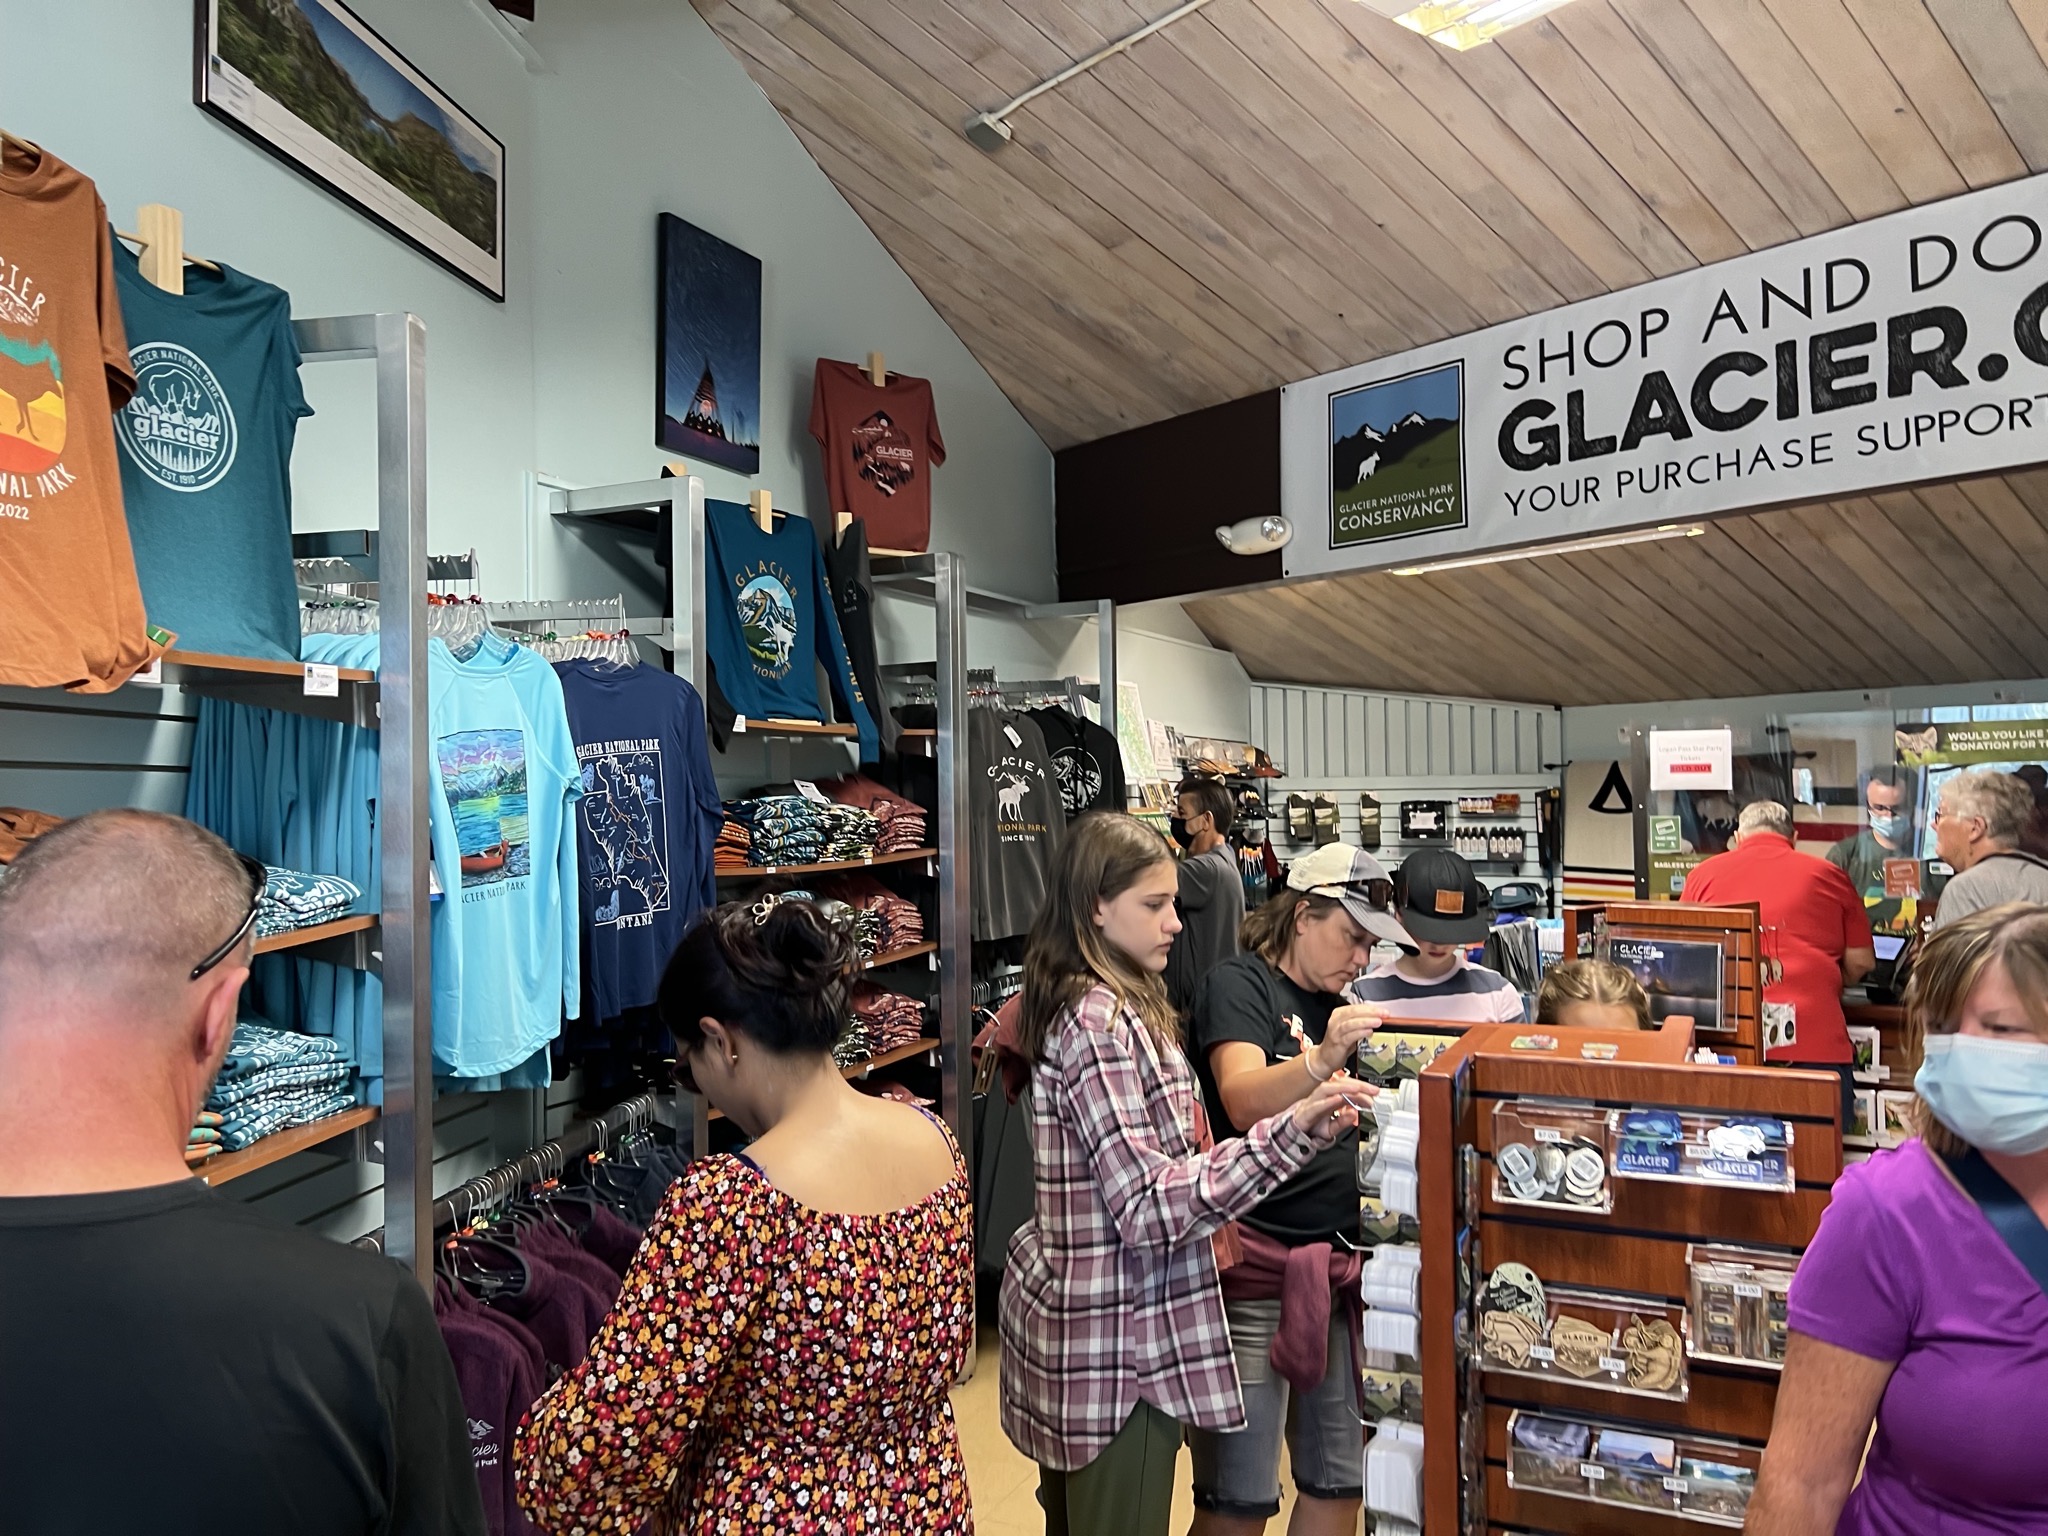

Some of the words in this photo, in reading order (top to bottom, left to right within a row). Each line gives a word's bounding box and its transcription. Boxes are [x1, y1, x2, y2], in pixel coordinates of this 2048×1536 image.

[1503, 307, 1670, 390] SHOP
[1702, 257, 1870, 343] AND
[1909, 214, 2042, 293] DO
[160, 350, 201, 376] NATIONAL
[202, 374, 220, 399] PARK
[134, 412, 220, 449] glacier
[876, 445, 913, 458] GLACIER
[161, 468, 178, 483] EST.
[1504, 476, 1601, 517] YOUR
[1616, 432, 1834, 498] PURCHASE
[1339, 498, 1378, 514] GLACIER
[1380, 489, 1427, 506] NATIONAL
[1429, 483, 1454, 496] PARK
[0, 503, 29, 520] 2022
[1339, 496, 1455, 531] CONSERVANCY
[735, 560, 798, 600] GLACIER
[1948, 731, 1990, 741] WOULD
[1992, 730, 2017, 740] YOU
[2019, 729, 2044, 739] LIKE
[604, 740, 640, 753] NATIONAL
[640, 738, 660, 751] PARK
[1951, 741, 2010, 751] DONATION
[2013, 740, 2036, 749] FOR
[1027, 823, 1047, 832] PARK
[1001, 834, 1023, 843] SINCE
[1654, 861, 1685, 869] BAGLESS
[506, 881, 526, 891] PARK
[1622, 1153, 1670, 1168] GLACIER
[1562, 1333, 1599, 1343] GLACIER
[481, 1456, 498, 1467] Park
